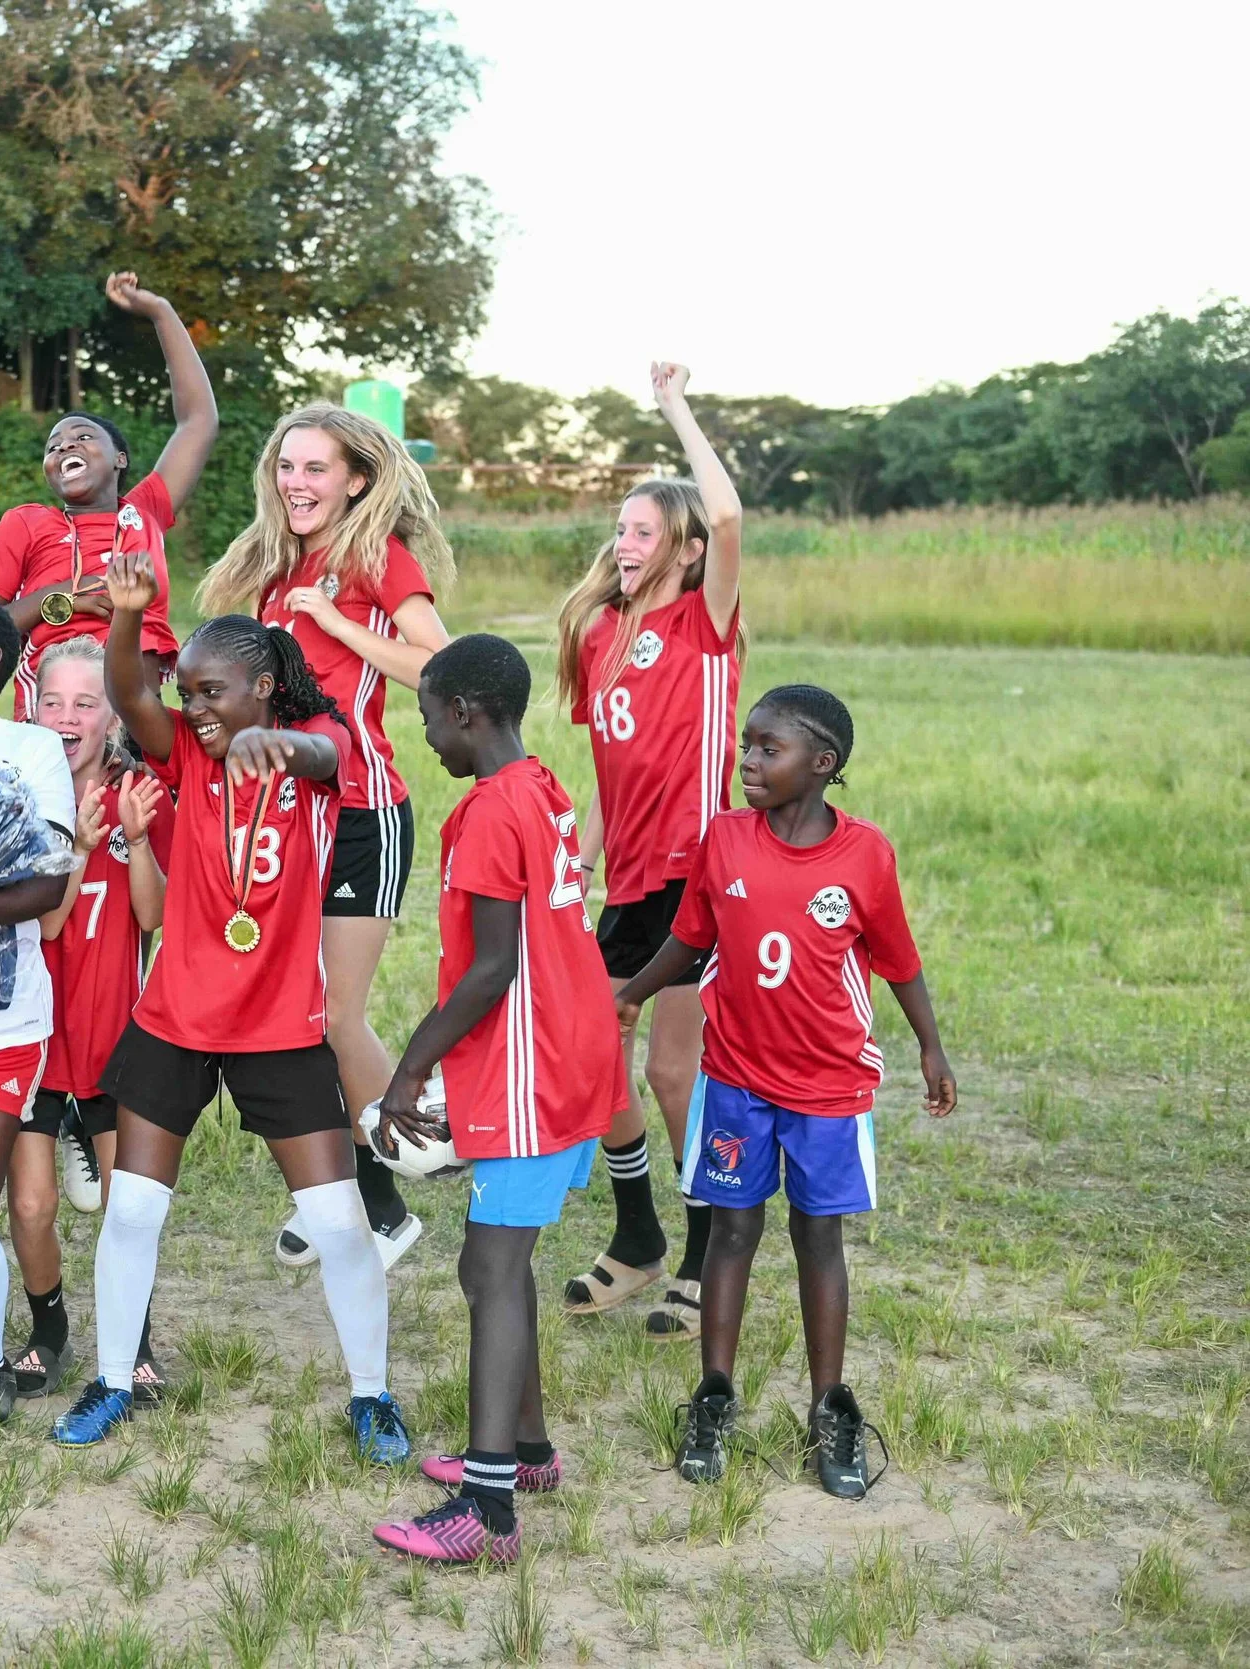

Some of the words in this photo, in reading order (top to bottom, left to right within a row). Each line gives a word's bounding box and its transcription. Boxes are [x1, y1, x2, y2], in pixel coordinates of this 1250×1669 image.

[593, 687, 635, 744] 48
[233, 824, 280, 883] 13
[80, 881, 107, 939] 7
[807, 896, 850, 916] HORNETS
[758, 931, 791, 988] 9
[706, 1168, 742, 1185] MAFA
